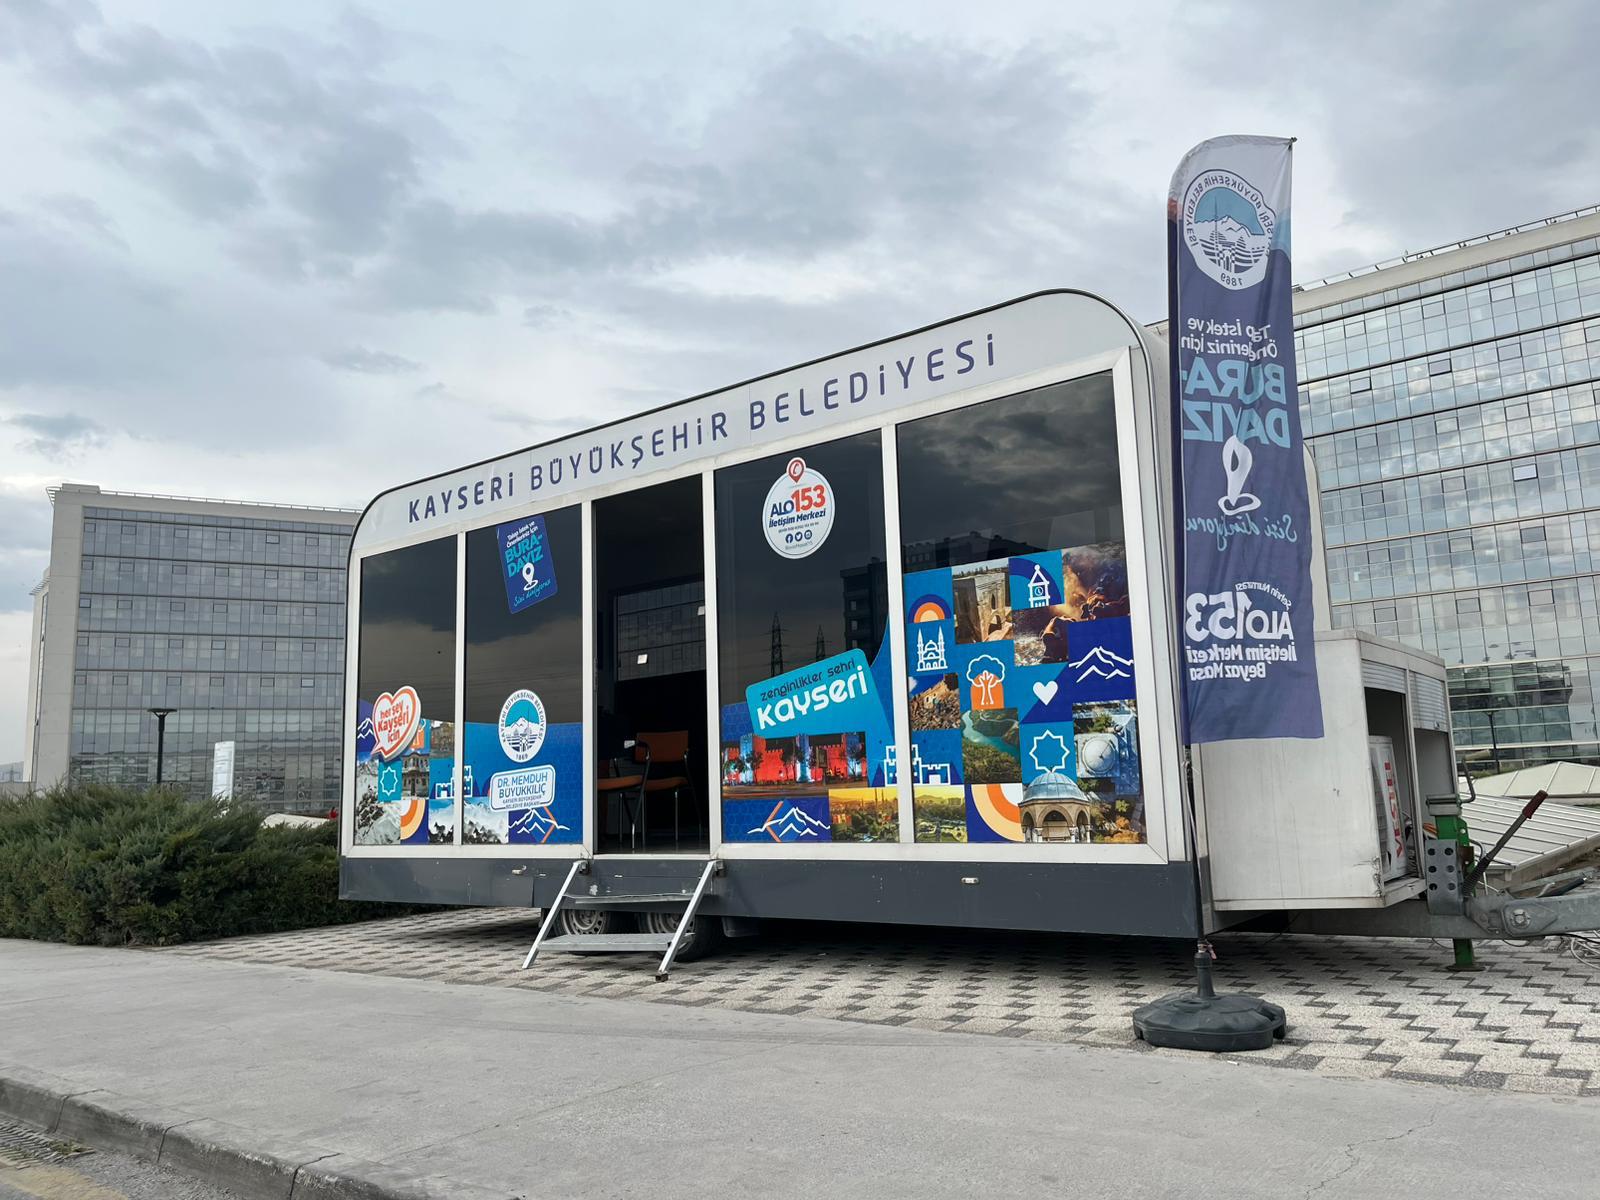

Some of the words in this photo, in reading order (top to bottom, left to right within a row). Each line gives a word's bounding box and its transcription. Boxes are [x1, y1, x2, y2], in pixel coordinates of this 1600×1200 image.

[408, 472, 514, 523] KAYSERİ
[530, 412, 728, 491] BÜYÜKŞEHİR
[750, 333, 994, 431] BELEDİYESİ
[769, 515, 795, 528] İletişim
[796, 508, 827, 523] Merkezi
[507, 545, 544, 577] DAYIZ
[757, 665, 868, 730] kayseri
[760, 671, 823, 701] zenginlikler
[497, 777, 510, 788] DR.
[511, 772, 548, 786] MEMDUH
